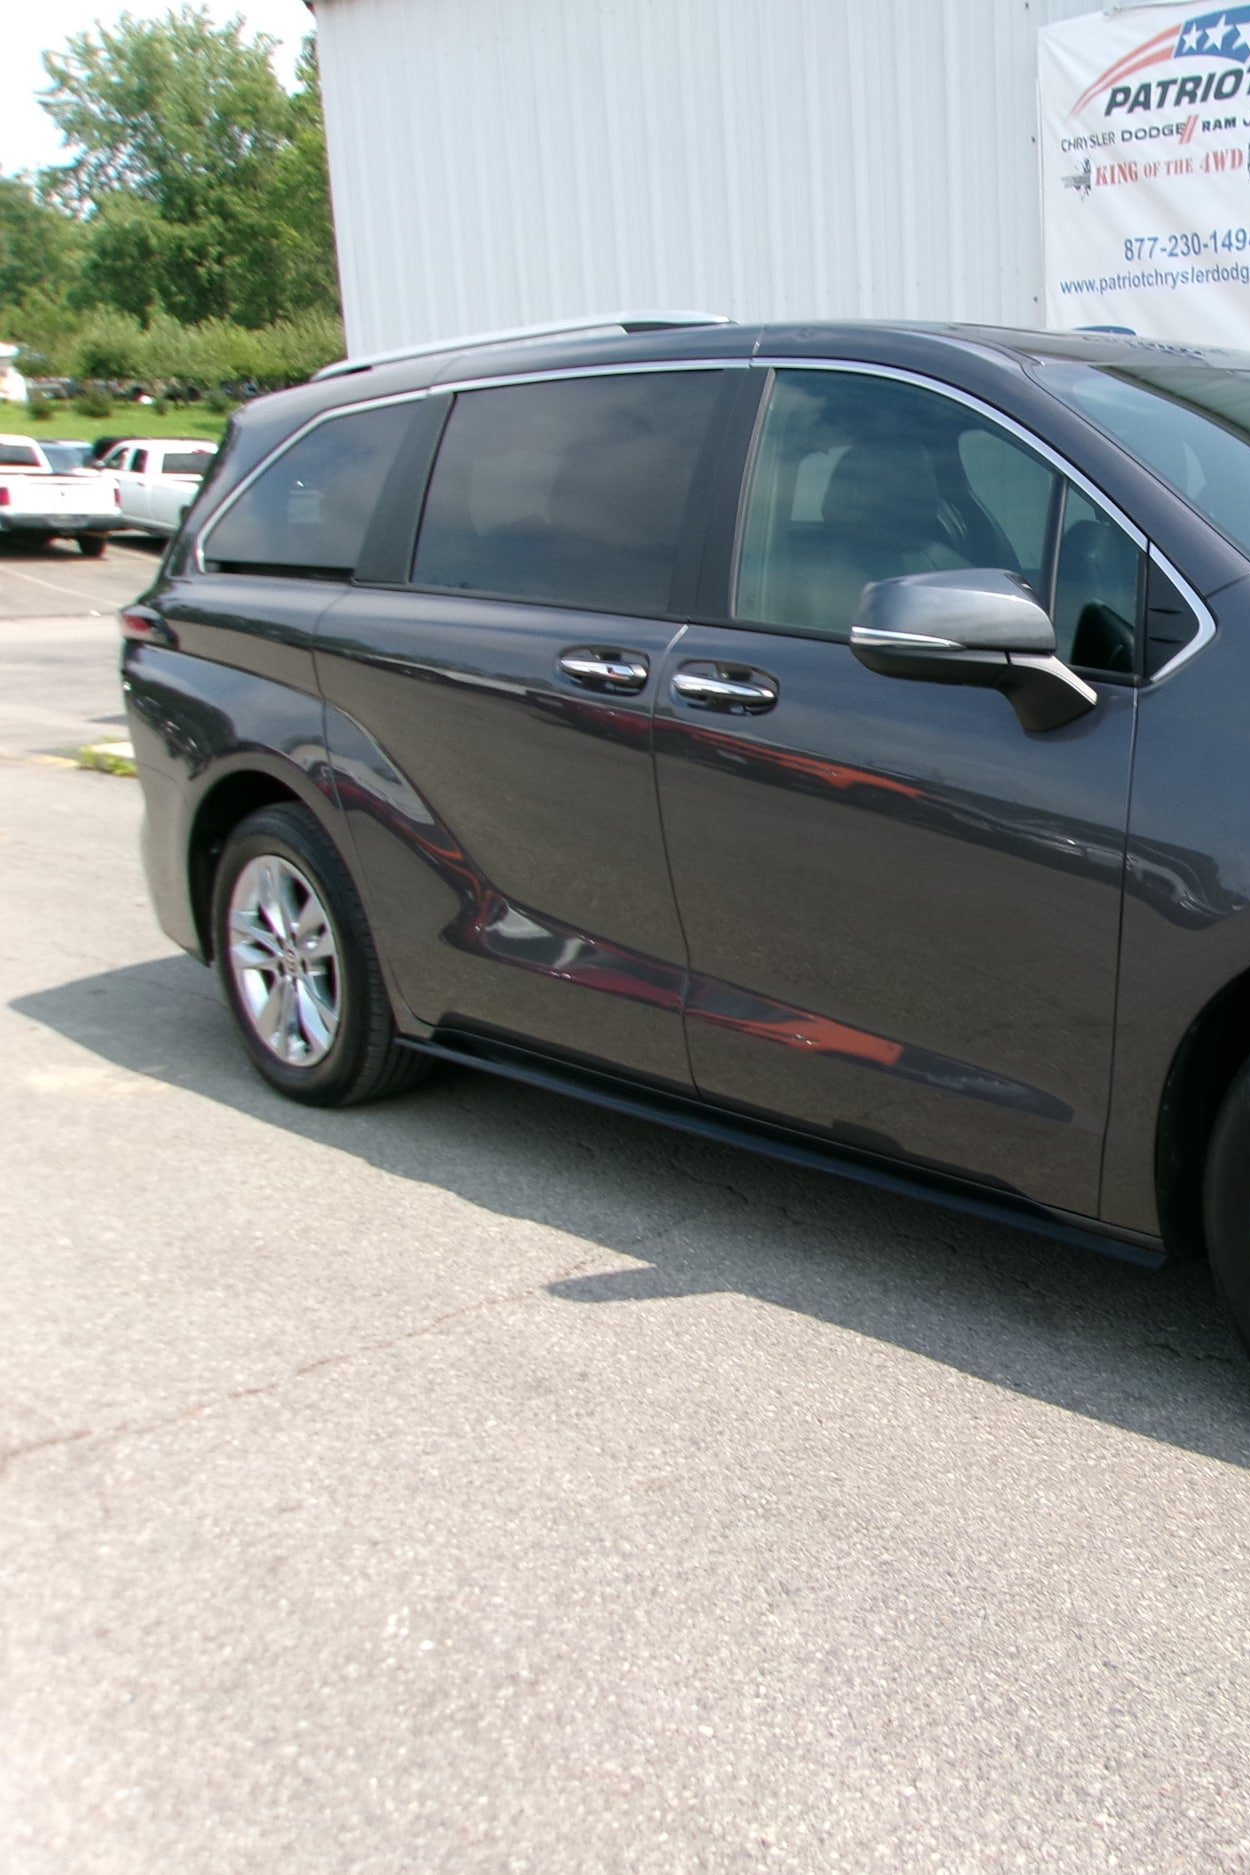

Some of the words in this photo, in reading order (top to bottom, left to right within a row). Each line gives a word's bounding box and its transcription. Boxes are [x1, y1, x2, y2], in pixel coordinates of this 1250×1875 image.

[1061, 132, 1115, 153] CHRYSLER
[1121, 122, 1185, 143] DODGE
[1202, 117, 1237, 132] RAM
[1095, 160, 1139, 187] KING
[1144, 161, 1162, 177] OF
[1166, 158, 1194, 175] THE
[1200, 148, 1244, 173] 4WD
